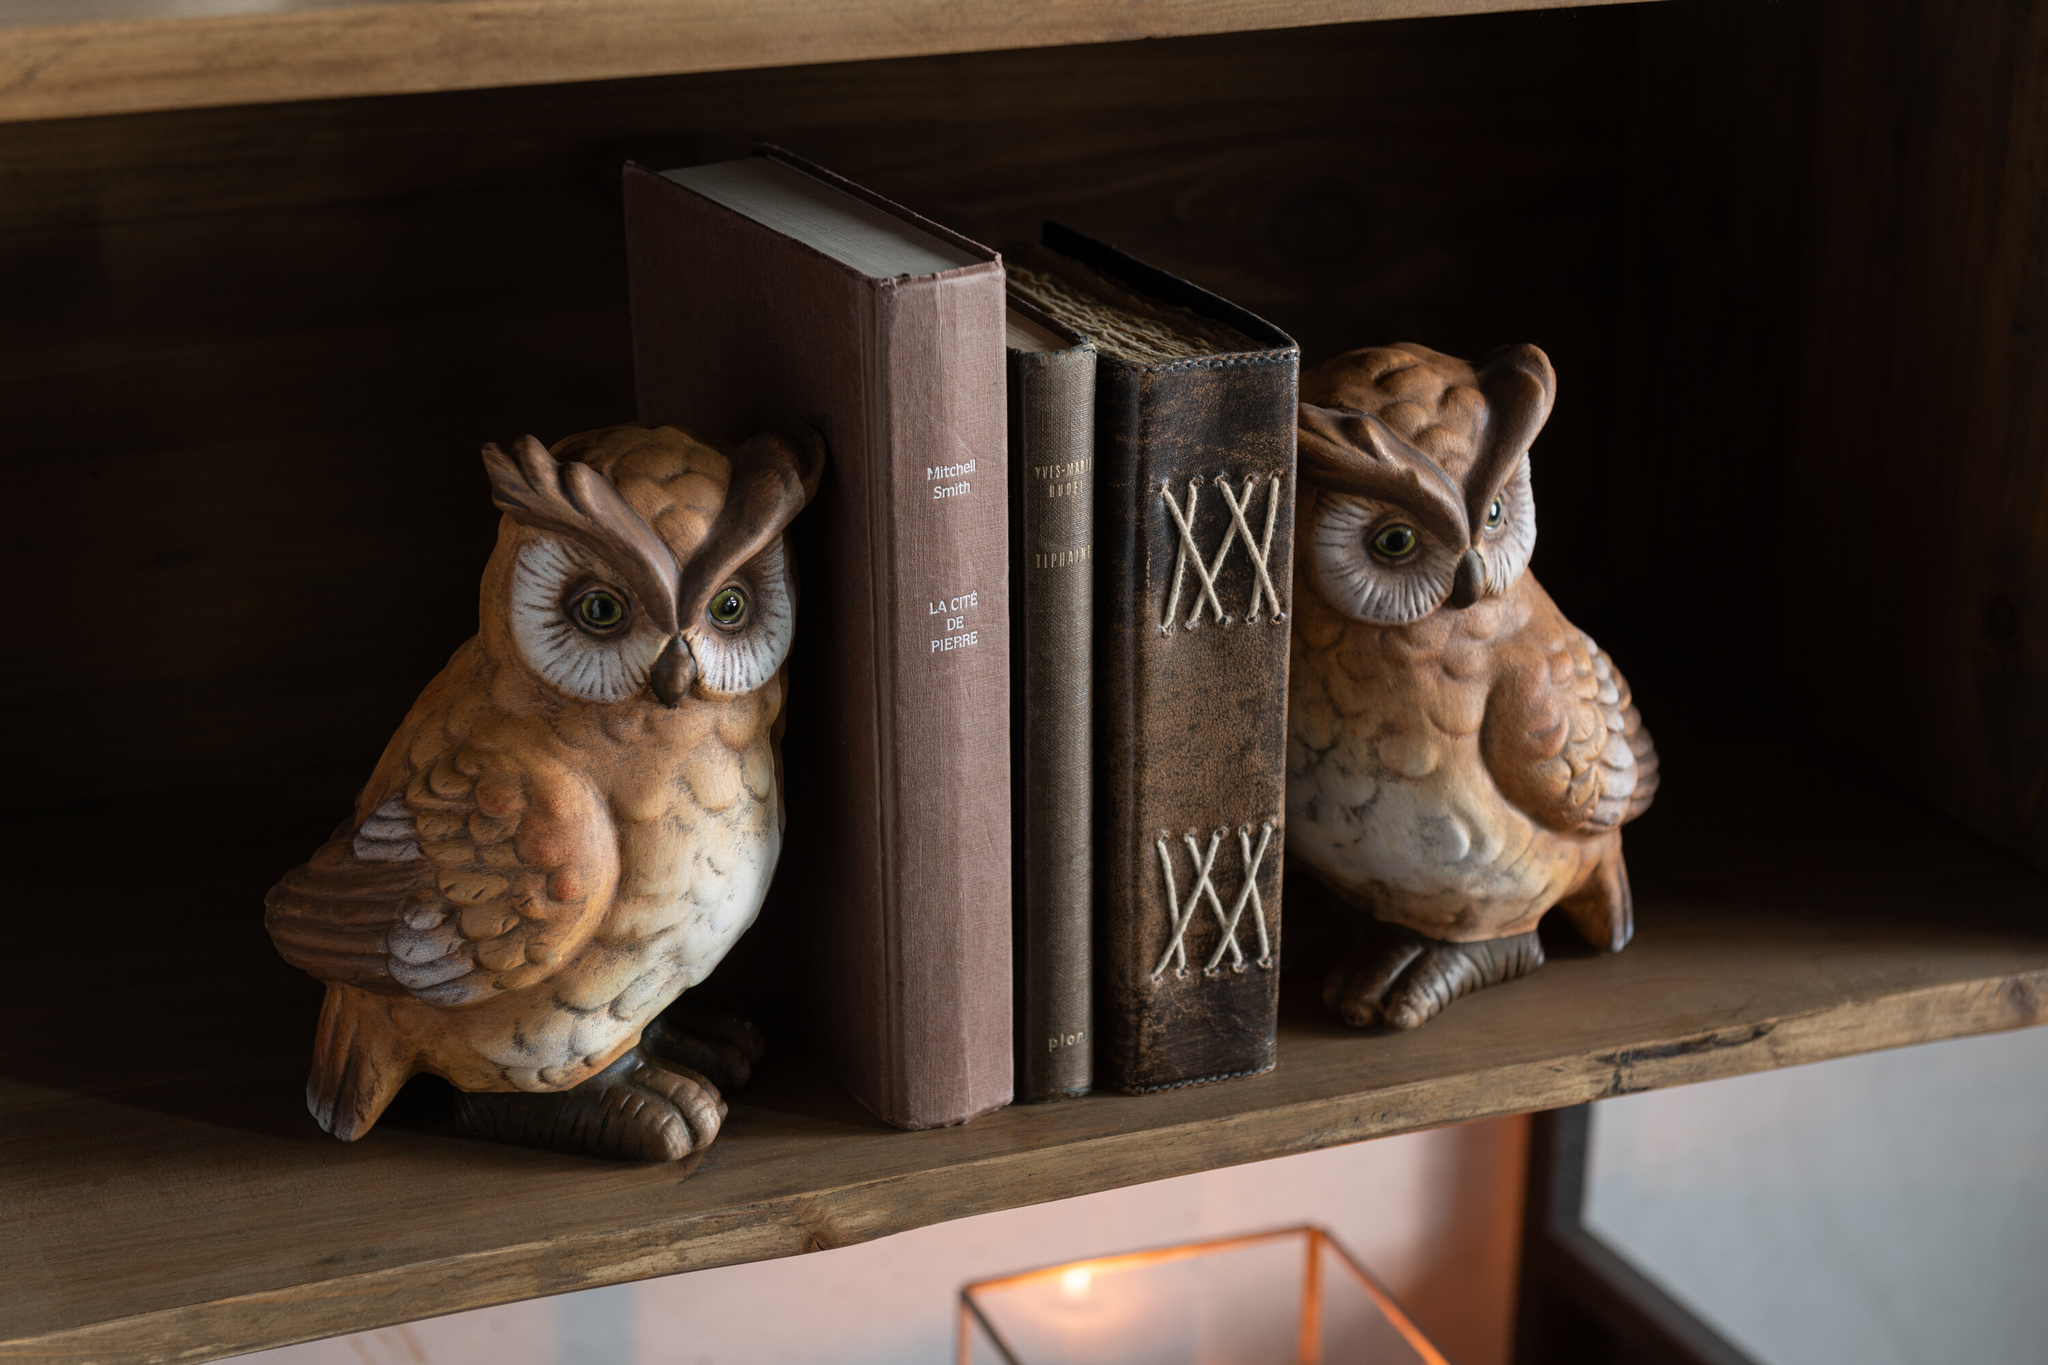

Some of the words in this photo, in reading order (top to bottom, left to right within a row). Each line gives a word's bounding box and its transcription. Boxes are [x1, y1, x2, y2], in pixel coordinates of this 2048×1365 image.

[927, 458, 976, 481] Mitchell
[933, 480, 972, 499] Smith
[930, 600, 948, 615] LA
[950, 589, 979, 611] CITÉ
[946, 615, 965, 632] DE
[931, 630, 979, 653] PIERRE
